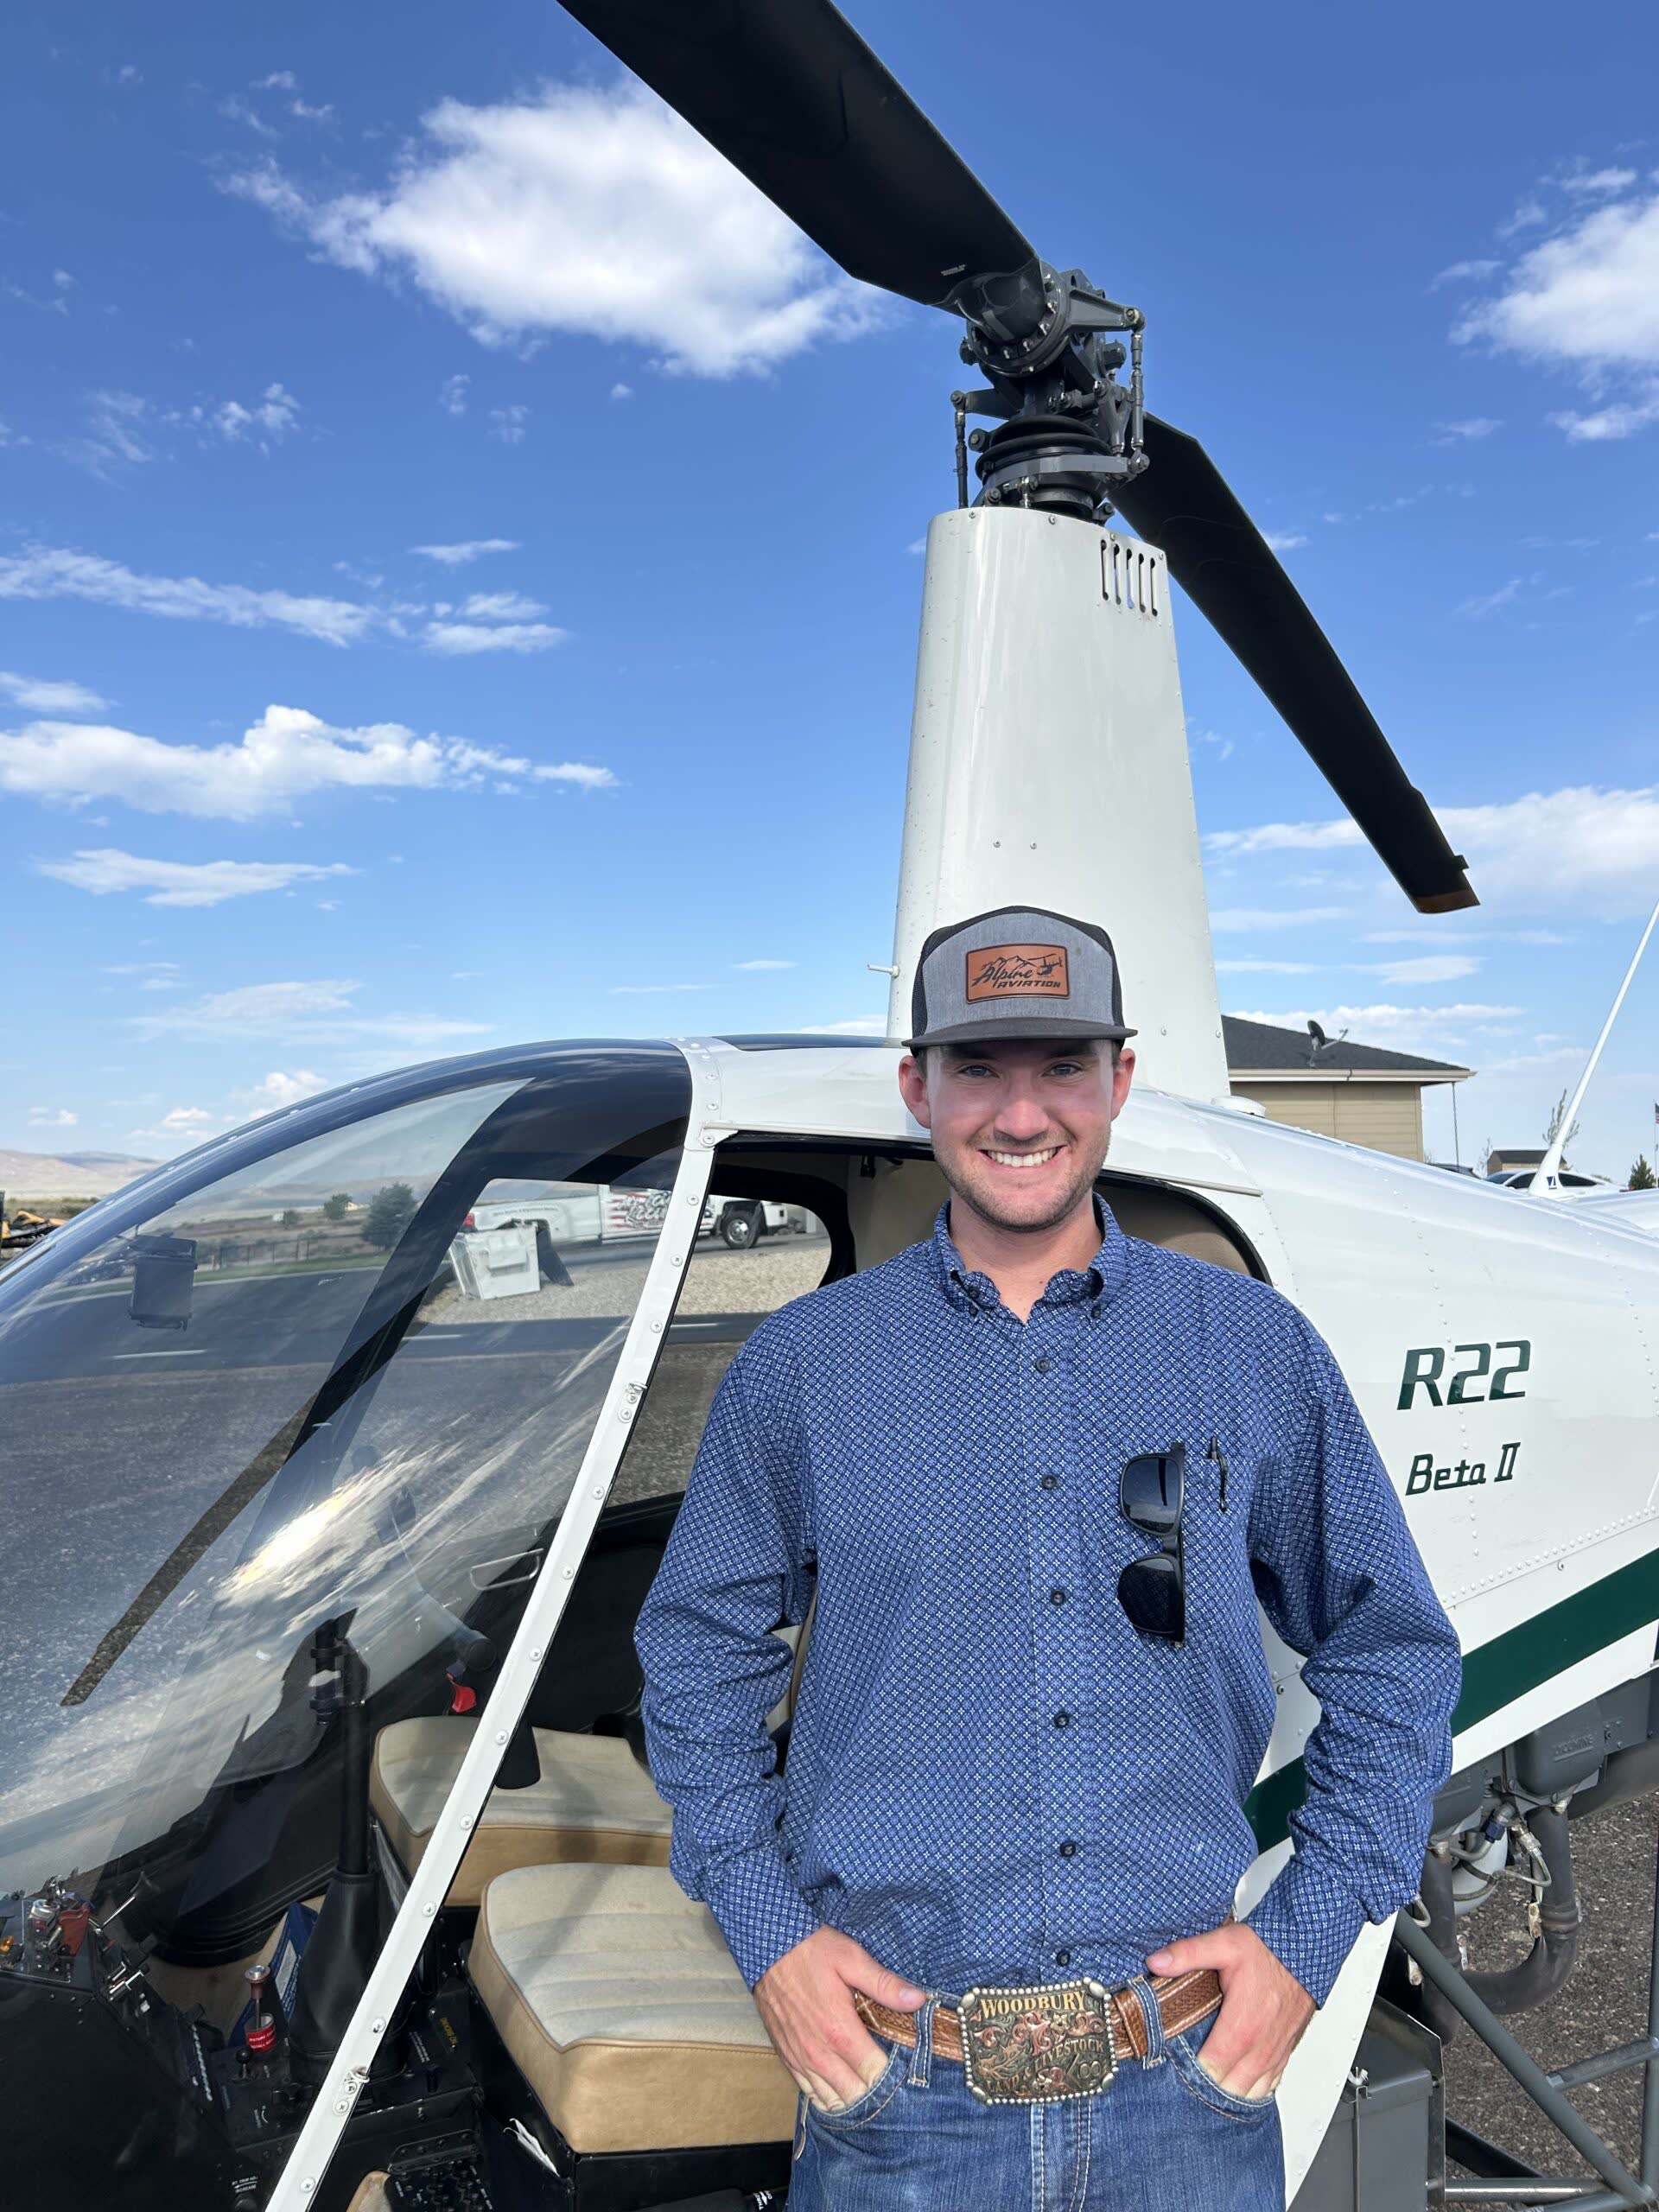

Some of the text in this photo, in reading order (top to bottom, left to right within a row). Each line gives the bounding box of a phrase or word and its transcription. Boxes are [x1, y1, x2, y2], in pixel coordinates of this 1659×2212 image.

[971, 963, 1033, 988] Alpine
[997, 980, 1061, 988] AVIATION
[1397, 1340, 1531, 1410] R22
[1405, 1441, 1521, 1496] Beta II
[980, 1990, 1087, 2018] WOODBURY
[986, 2075, 1019, 2092] LAND
[1034, 2038, 1104, 2071] LIVESTOCK
